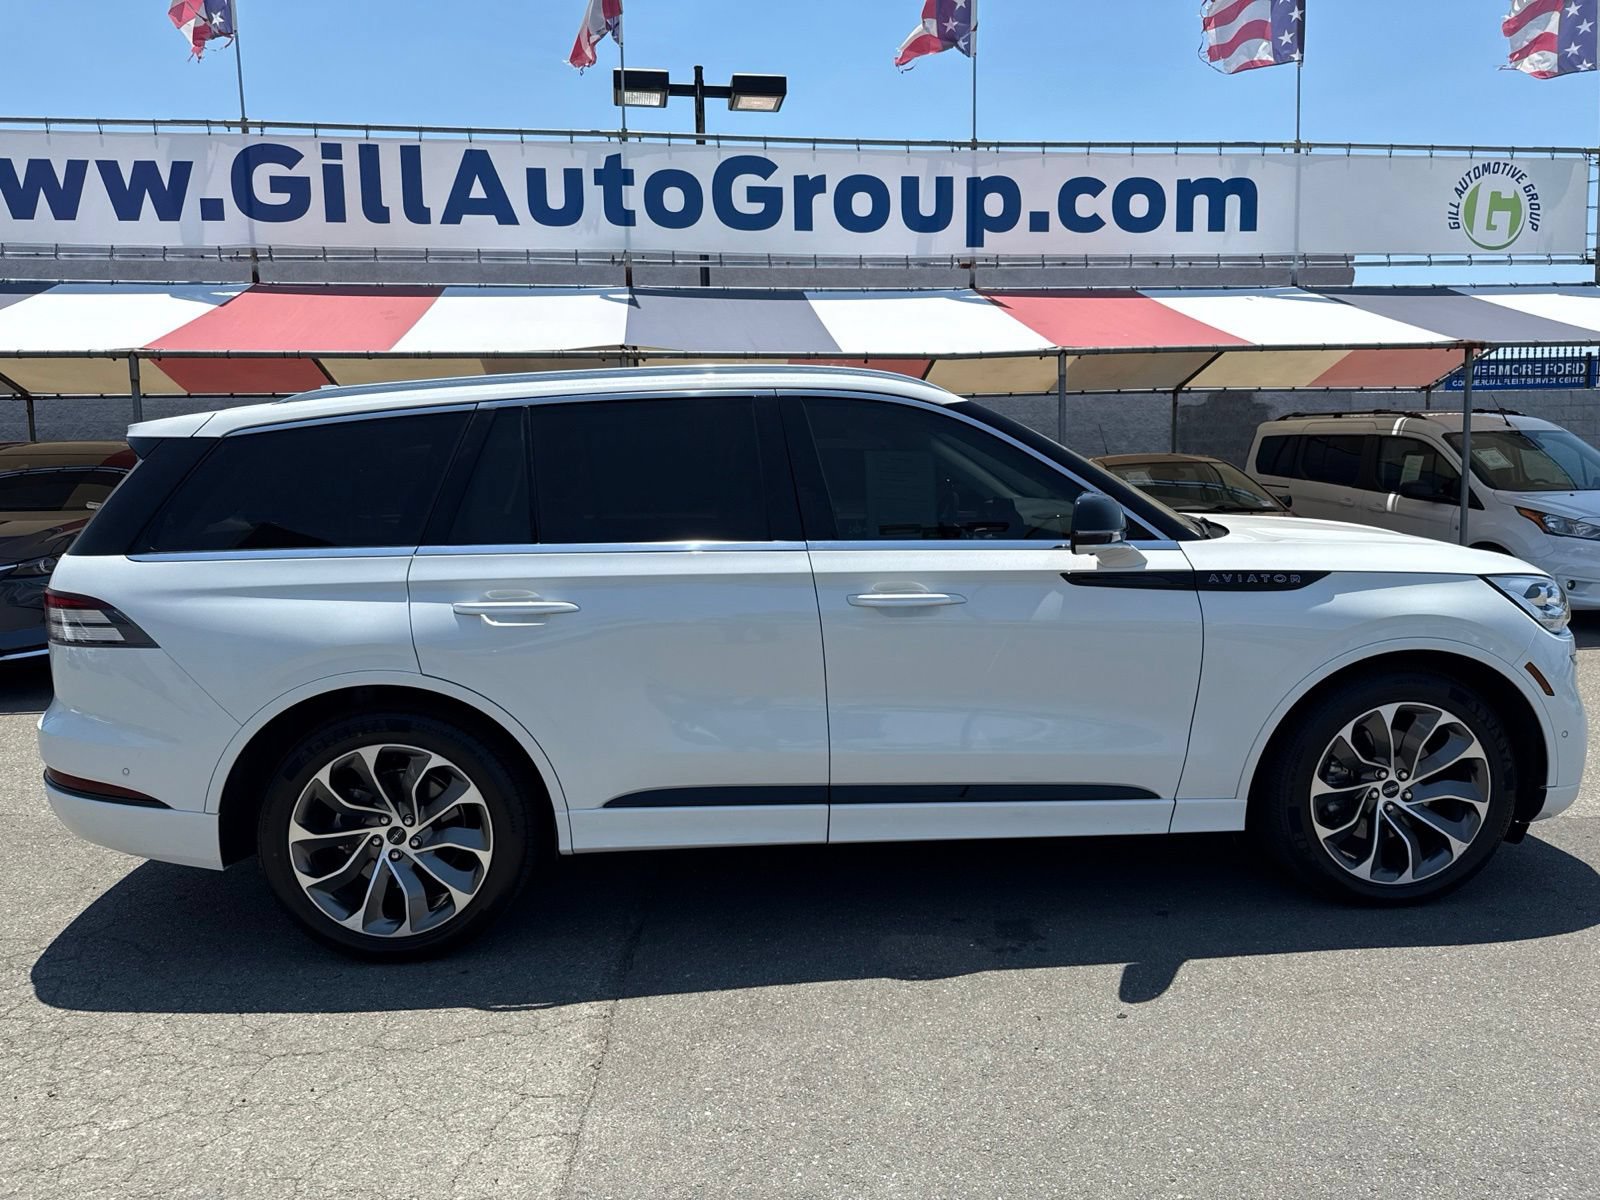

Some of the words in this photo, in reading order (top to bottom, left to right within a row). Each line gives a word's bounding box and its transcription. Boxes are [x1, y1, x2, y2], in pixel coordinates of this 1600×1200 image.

[1453, 161, 1528, 199] AUTOMOTIVE
[1448, 201, 1461, 230] GILL
[1522, 183, 1541, 232] GROUP
[1545, 362, 1586, 375] FORD
[1208, 573, 1301, 583] AVIATOR
